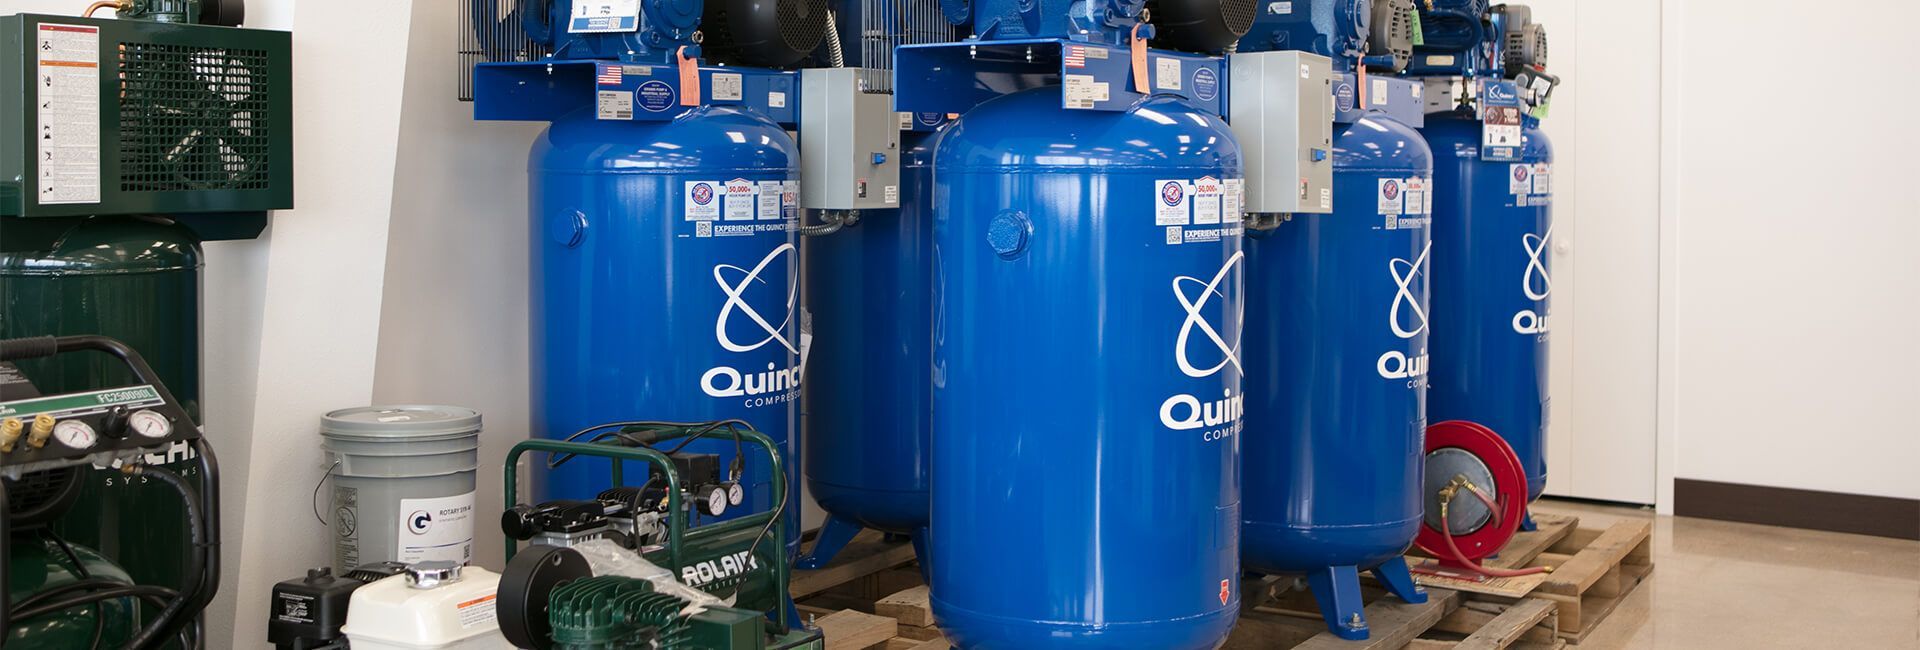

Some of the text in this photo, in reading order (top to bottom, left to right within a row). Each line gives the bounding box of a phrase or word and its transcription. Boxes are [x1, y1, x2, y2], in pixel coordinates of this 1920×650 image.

[714, 224, 754, 232] EXPERIENCE
[755, 223, 766, 231] THE
[1184, 229, 1220, 239] EXPERIENCE
[700, 362, 801, 397] Quinc
